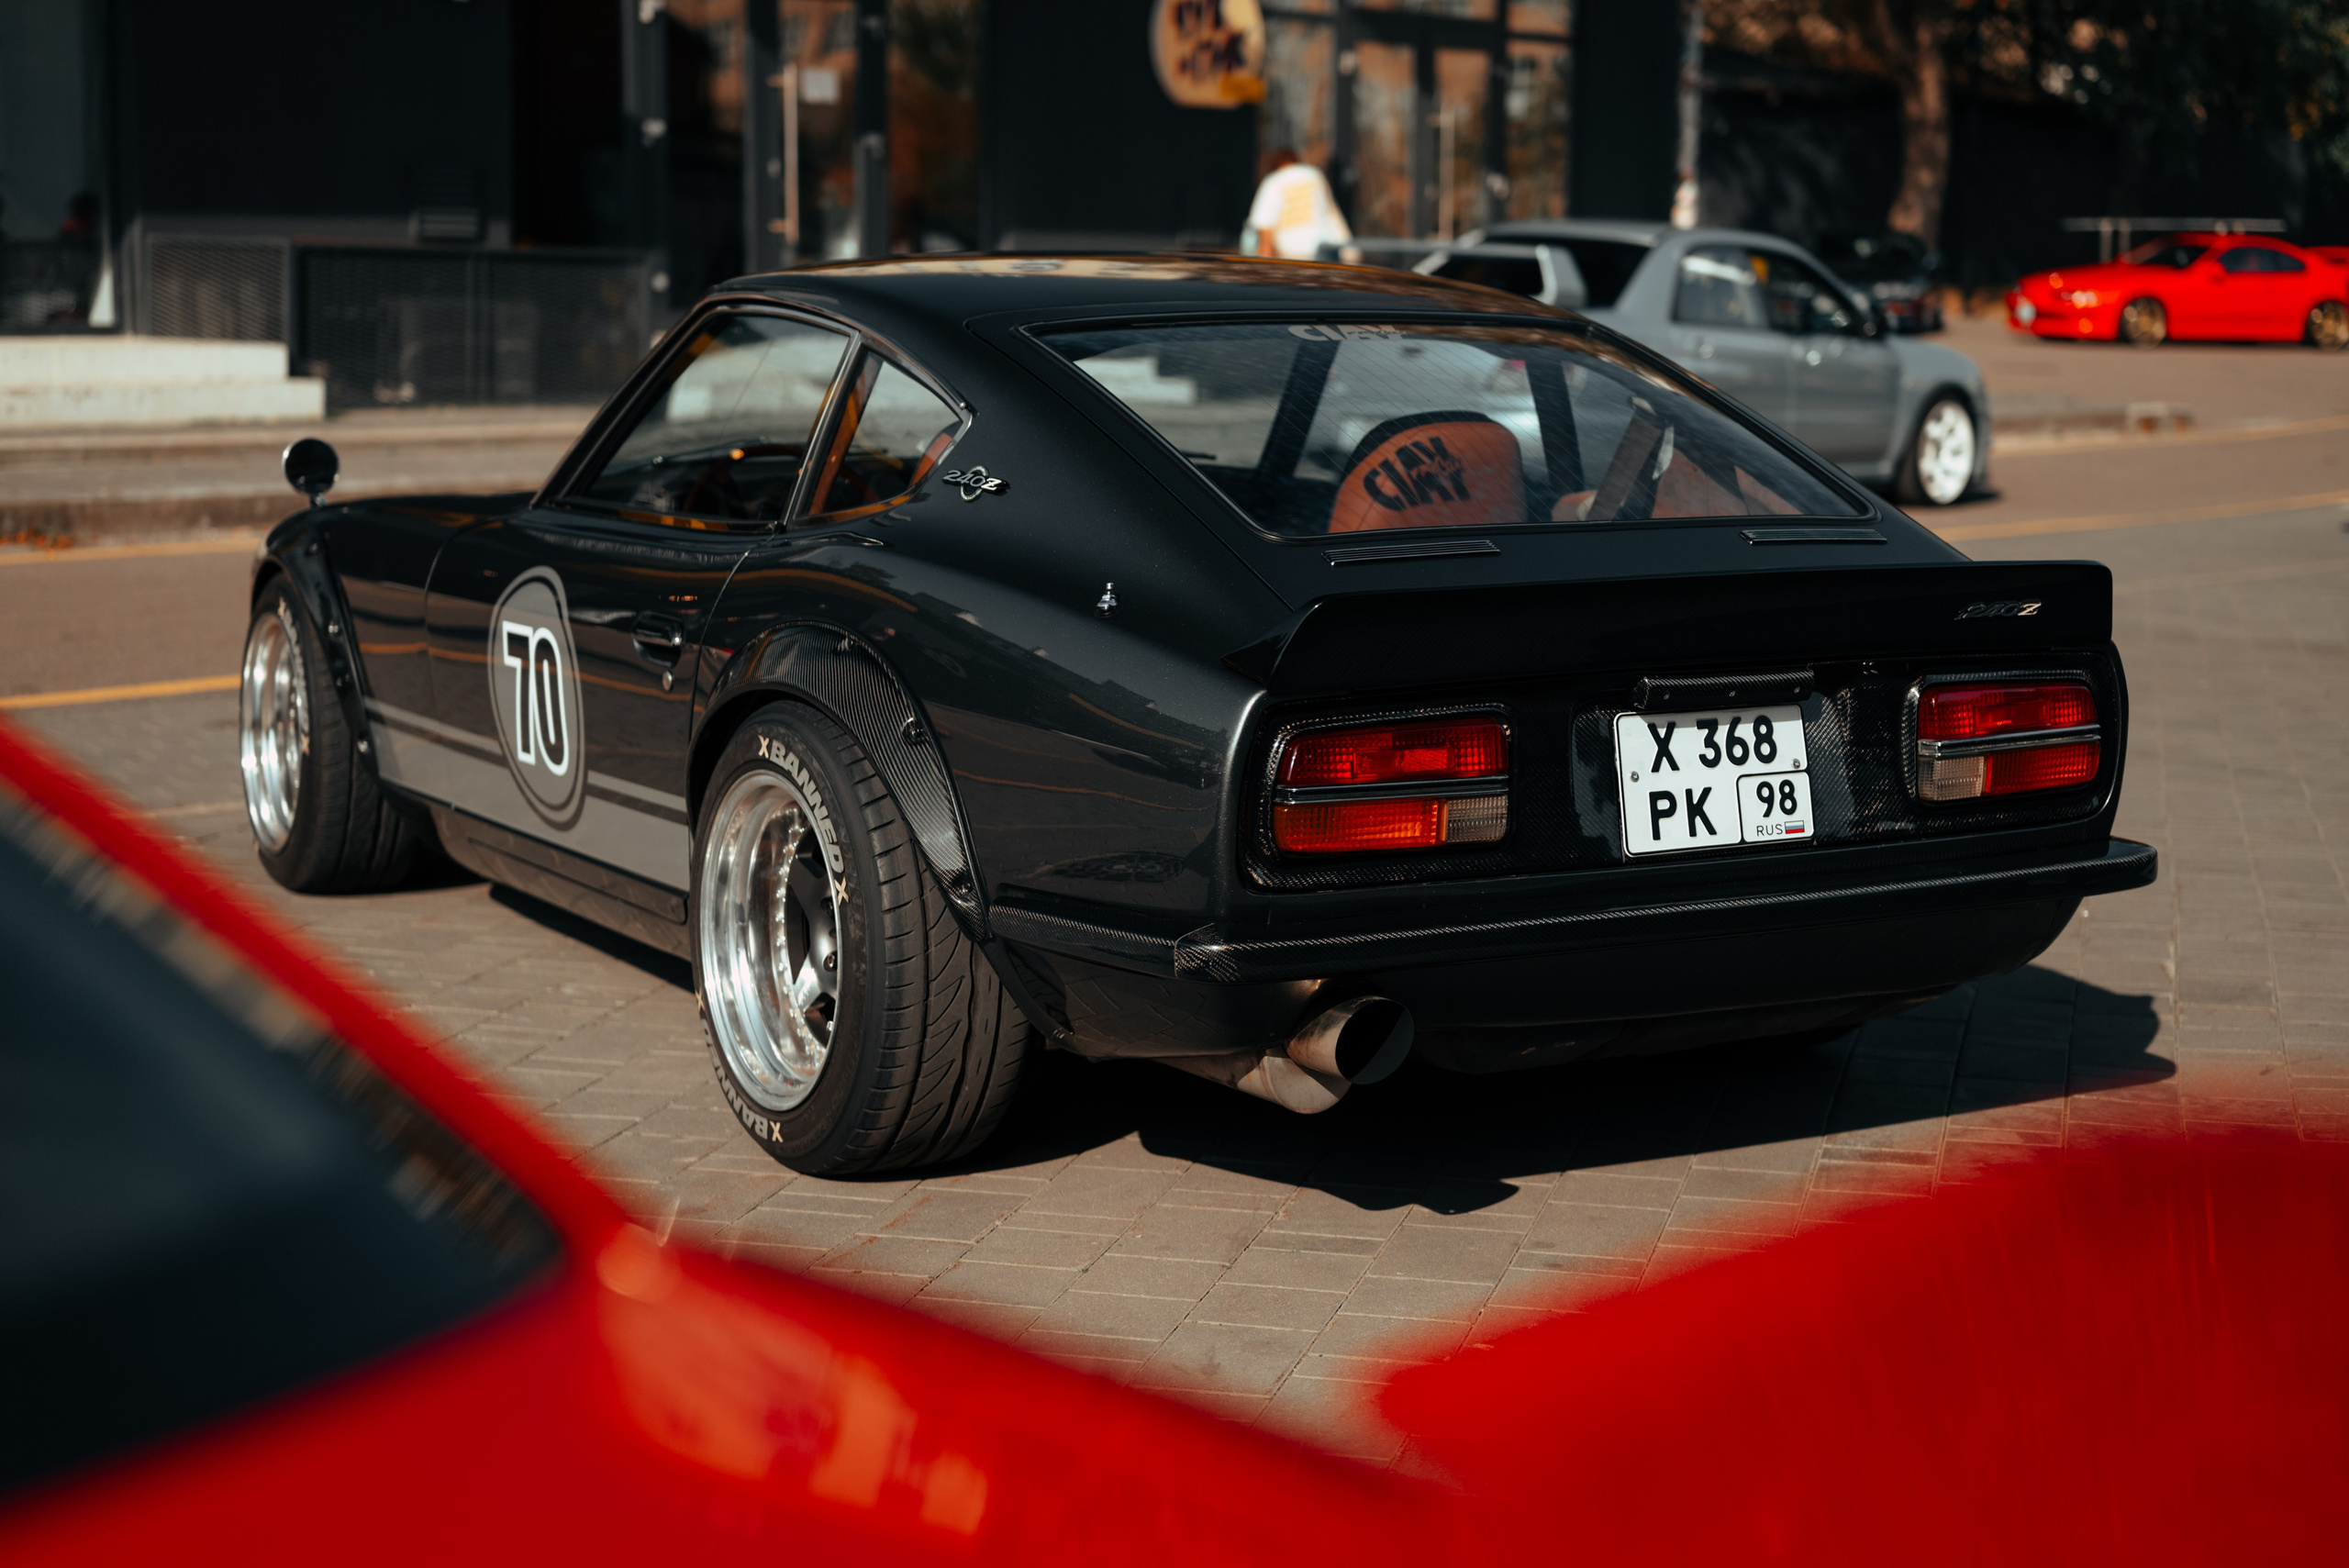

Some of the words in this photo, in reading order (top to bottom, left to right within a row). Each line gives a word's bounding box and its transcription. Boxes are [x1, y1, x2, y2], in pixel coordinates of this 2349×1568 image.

[942, 469, 1002, 491] 240Z
[1954, 602, 2043, 620] 240Z
[502, 619, 569, 777] 70
[1647, 720, 1680, 773] X
[1696, 715, 1777, 769] 368
[1649, 786, 1718, 841] PK
[1756, 779, 1798, 818] 98
[1756, 823, 1784, 837] RUS
